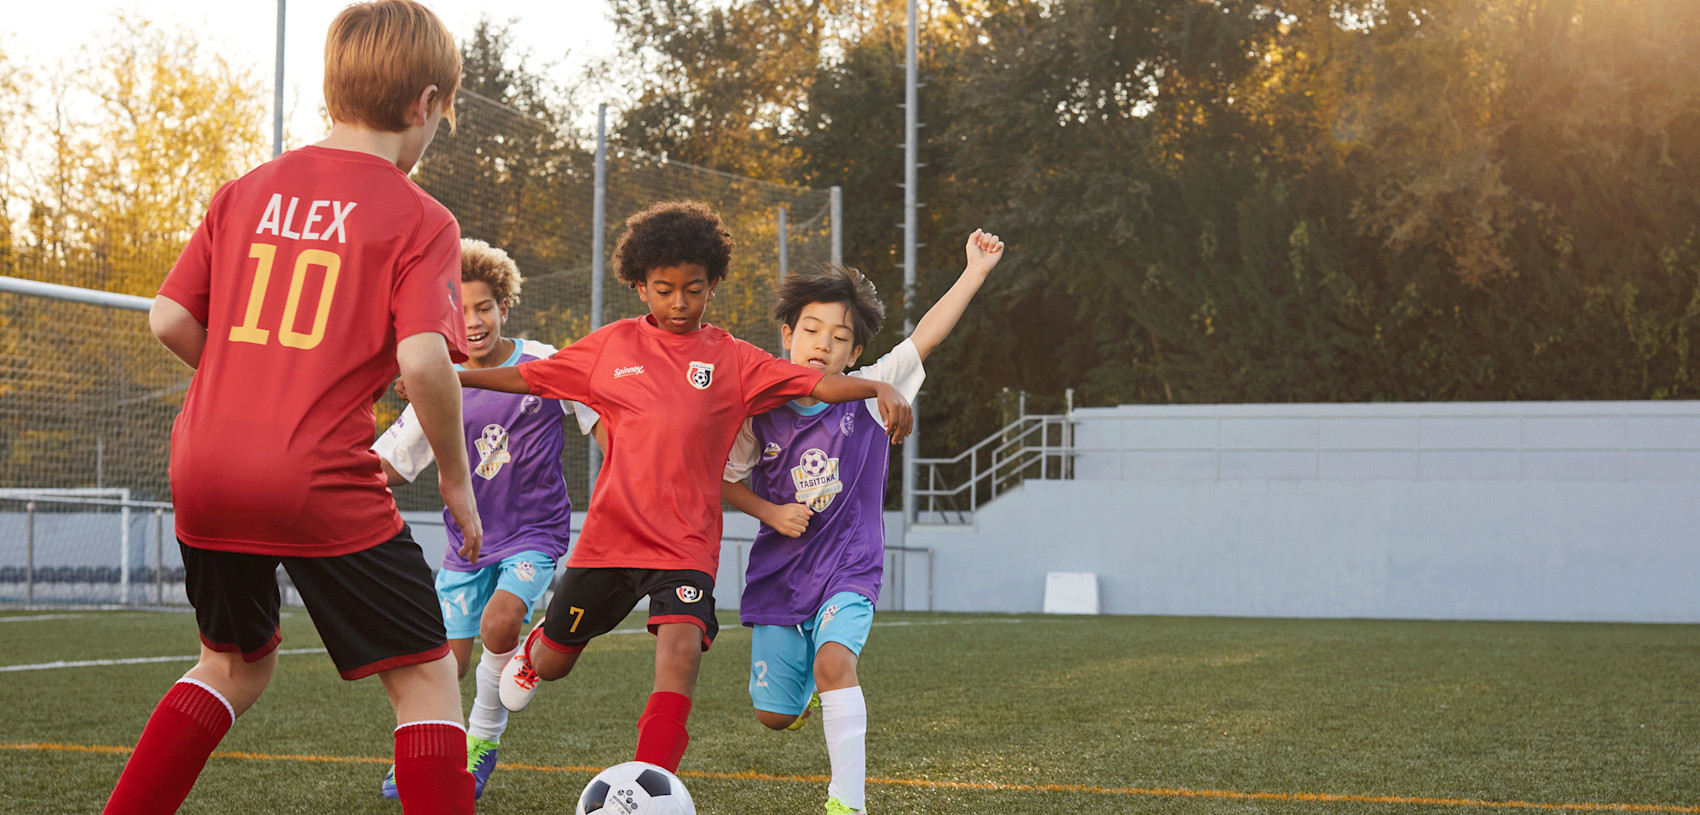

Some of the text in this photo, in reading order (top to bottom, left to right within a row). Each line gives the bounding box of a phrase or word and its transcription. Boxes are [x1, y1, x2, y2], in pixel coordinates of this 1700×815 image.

[255, 193, 357, 243] ALEX
[228, 243, 341, 349] 10
[799, 473, 836, 489] TASITOKA
[569, 606, 585, 633] 7
[754, 660, 768, 687] 2
